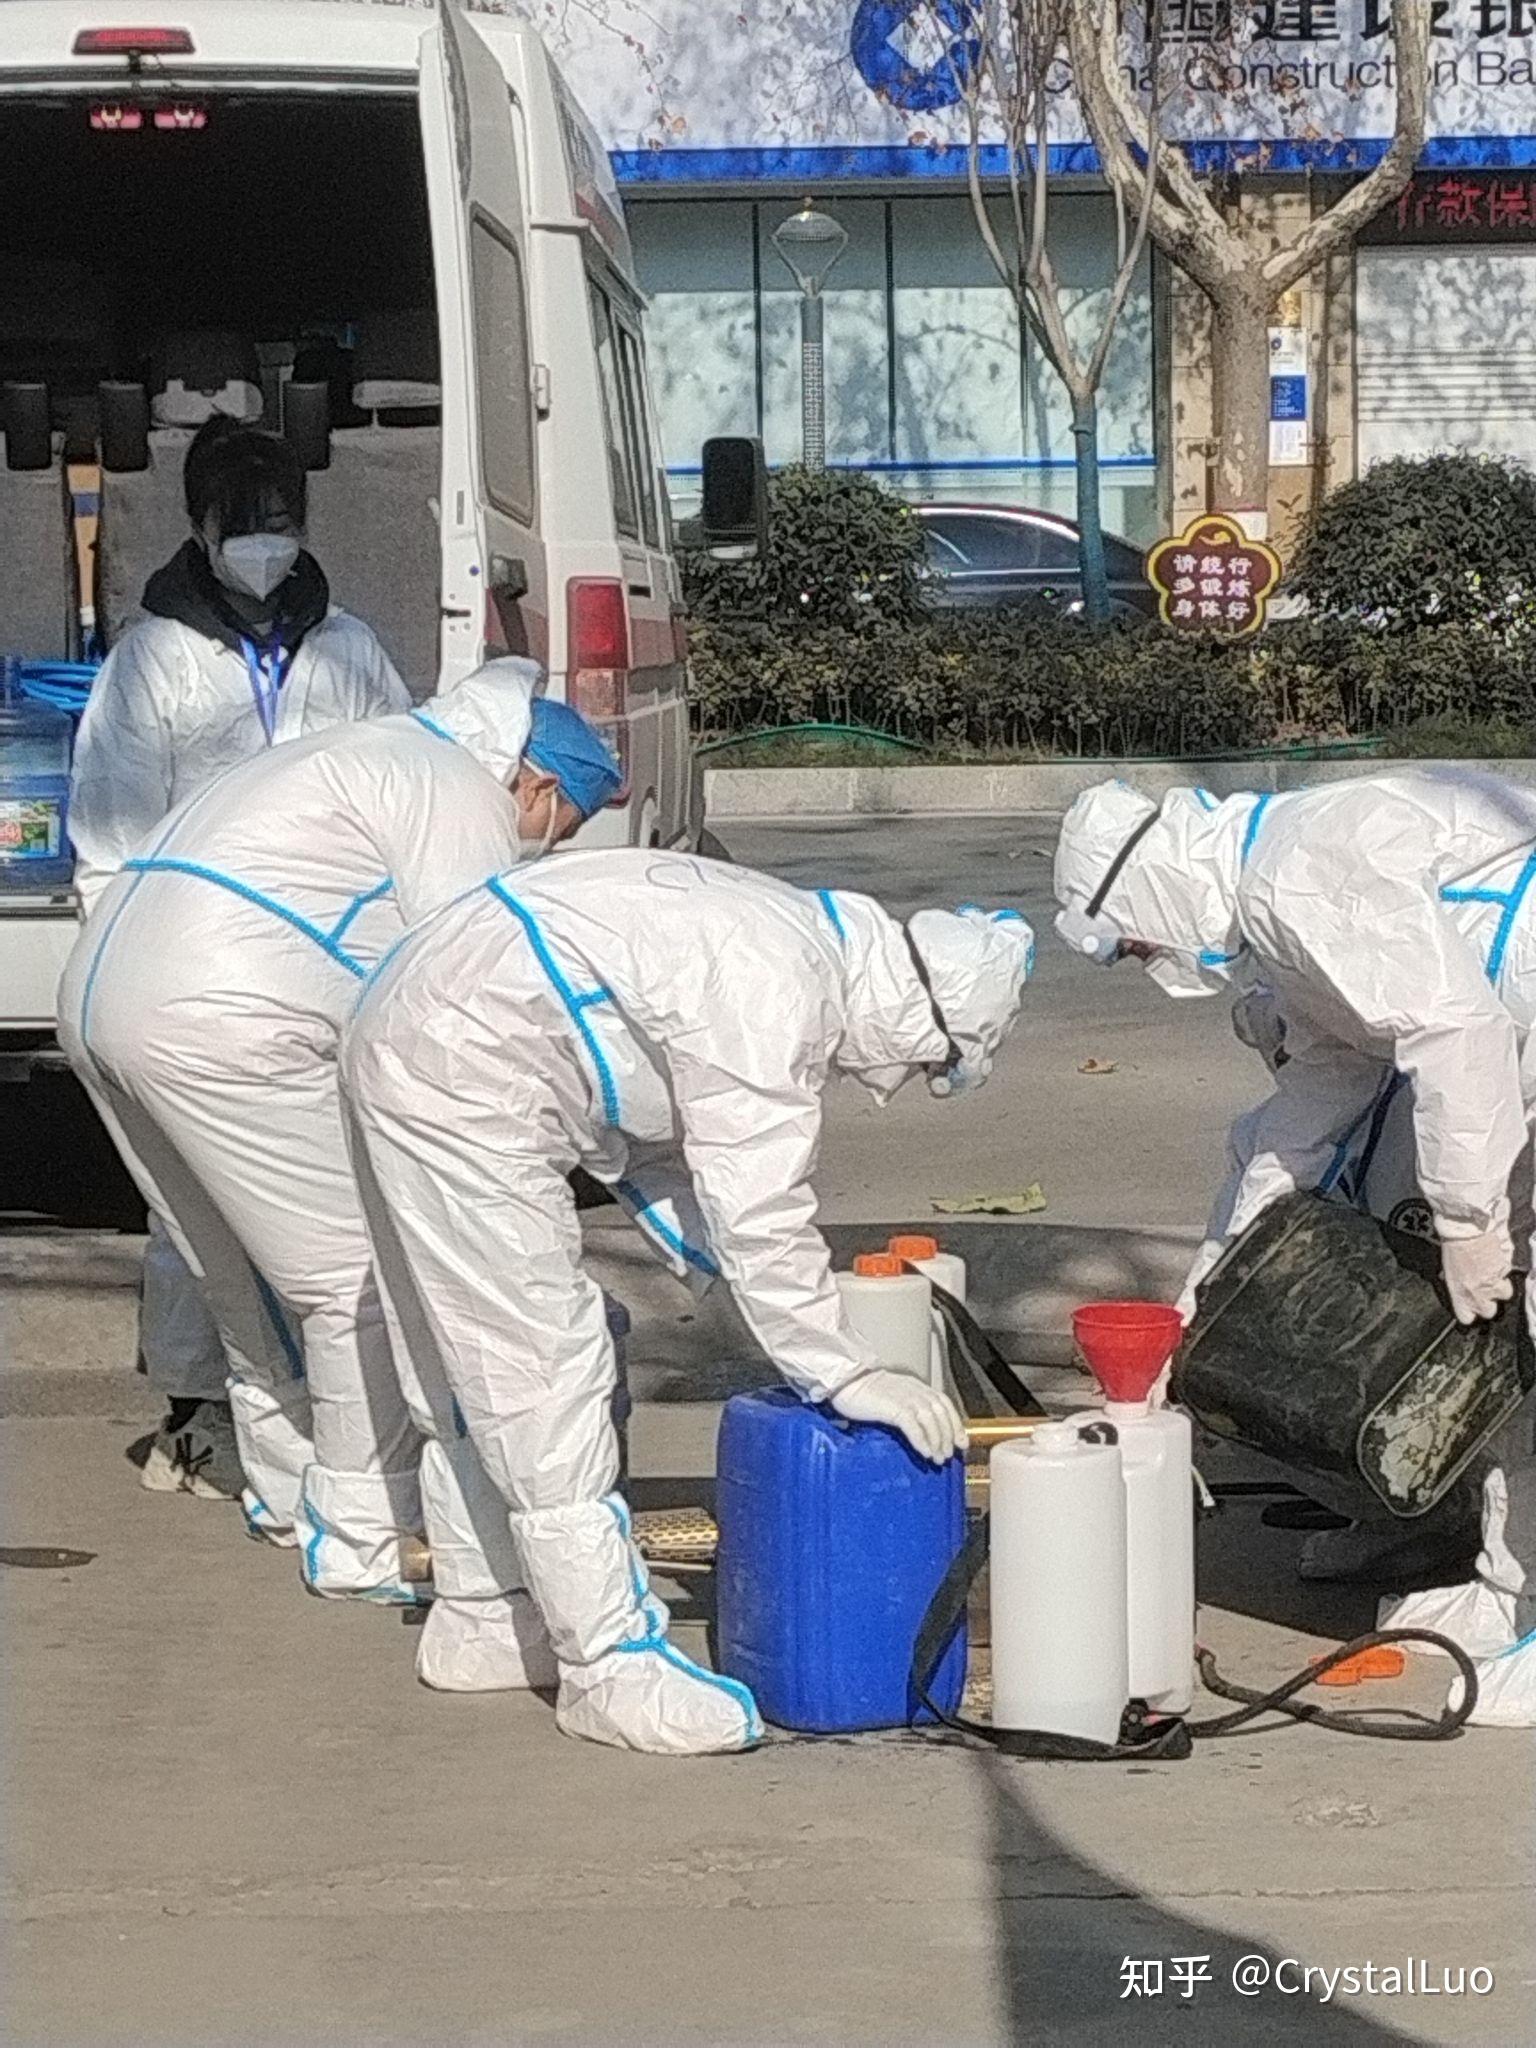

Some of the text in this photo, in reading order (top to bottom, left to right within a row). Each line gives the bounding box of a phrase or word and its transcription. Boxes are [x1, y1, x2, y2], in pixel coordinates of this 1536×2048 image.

[1184, 51, 1458, 95] Constructn
[1171, 576, 1252, 598] 多锻炼
[1171, 598, 1251, 620] 身体好
